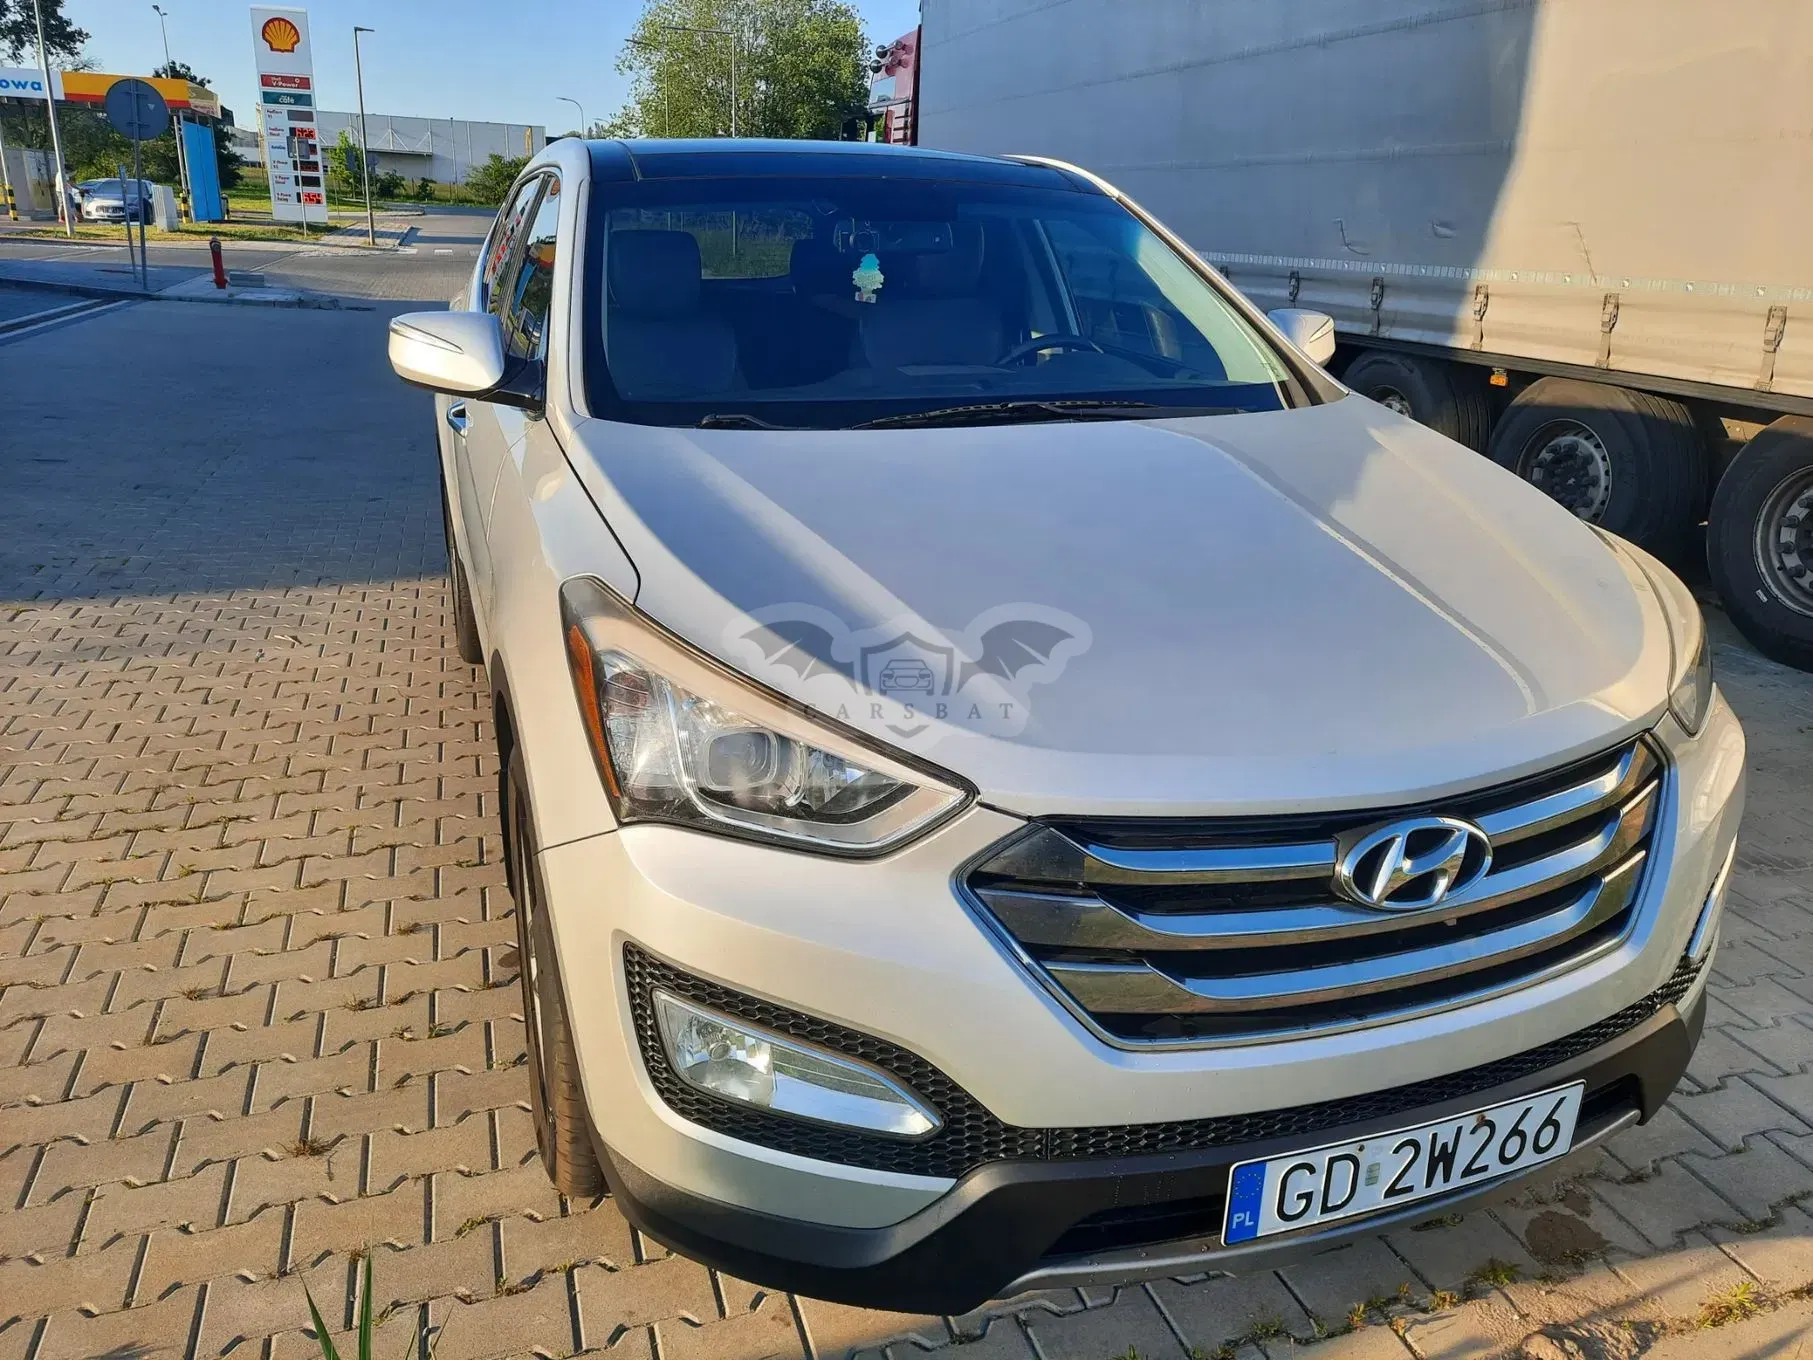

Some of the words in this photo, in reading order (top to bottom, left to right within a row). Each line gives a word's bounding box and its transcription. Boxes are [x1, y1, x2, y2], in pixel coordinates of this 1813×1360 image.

[1275, 1153, 1361, 1223] GD
[1382, 1095, 1568, 1201] 2W266
[1232, 1211, 1255, 1230] PL
